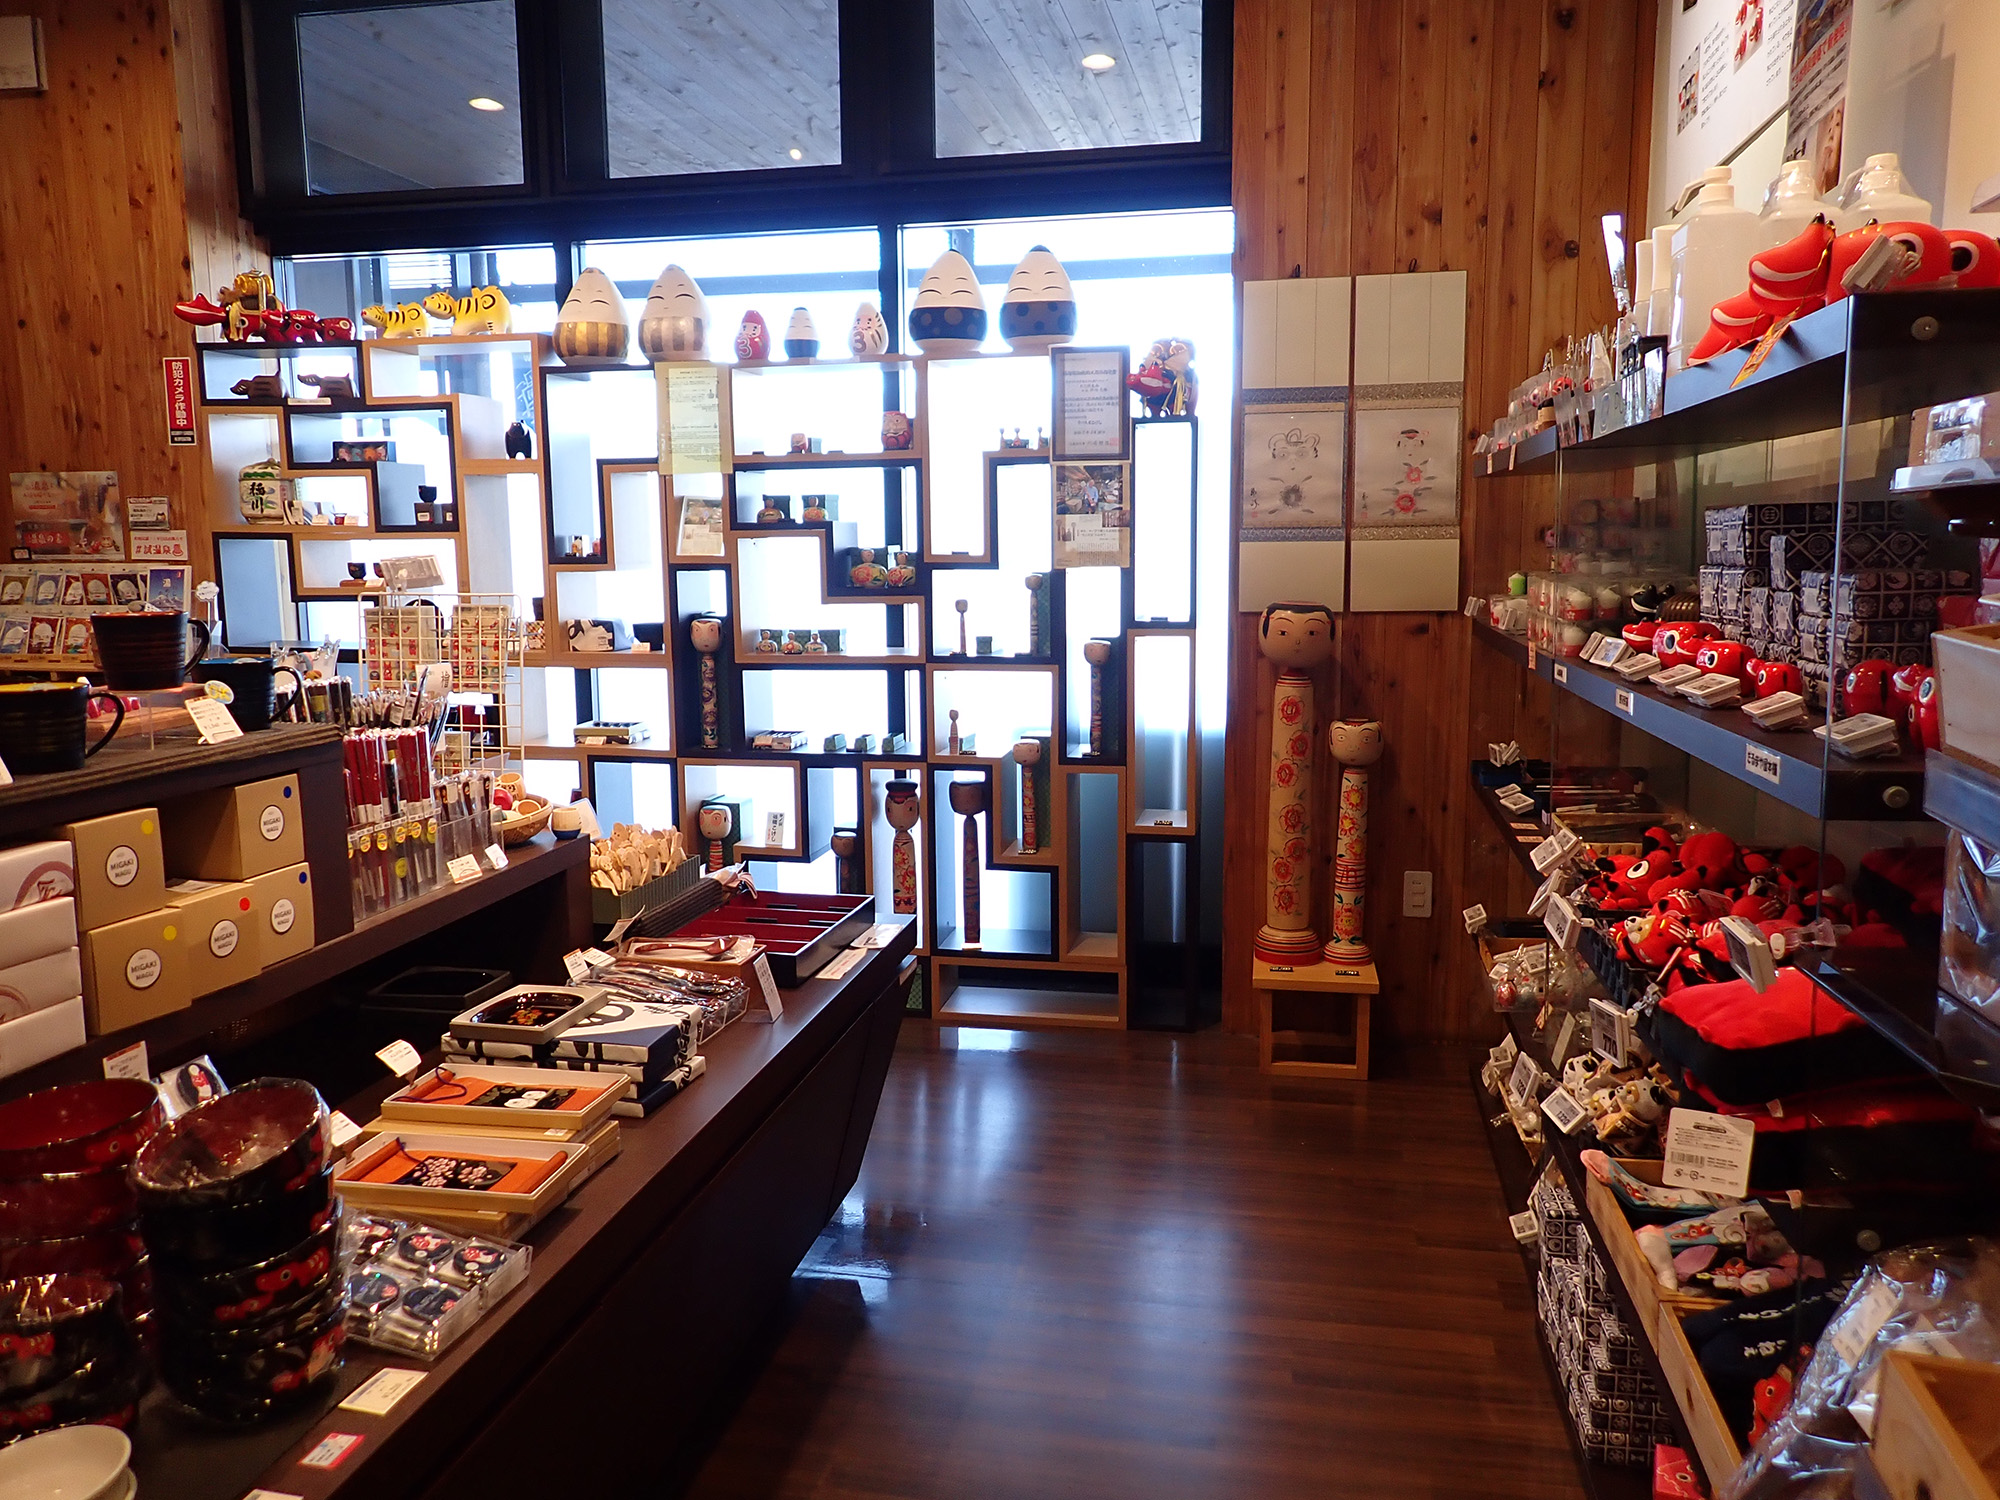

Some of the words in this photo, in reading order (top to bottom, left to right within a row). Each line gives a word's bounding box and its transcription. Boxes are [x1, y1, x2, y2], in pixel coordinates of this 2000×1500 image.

[171, 361, 188, 427] 防犯カメラ作動中
[110, 858, 134, 870] MIGAKI
[214, 930, 235, 943] MIGAKI
[131, 960, 157, 973] MIGAKI
